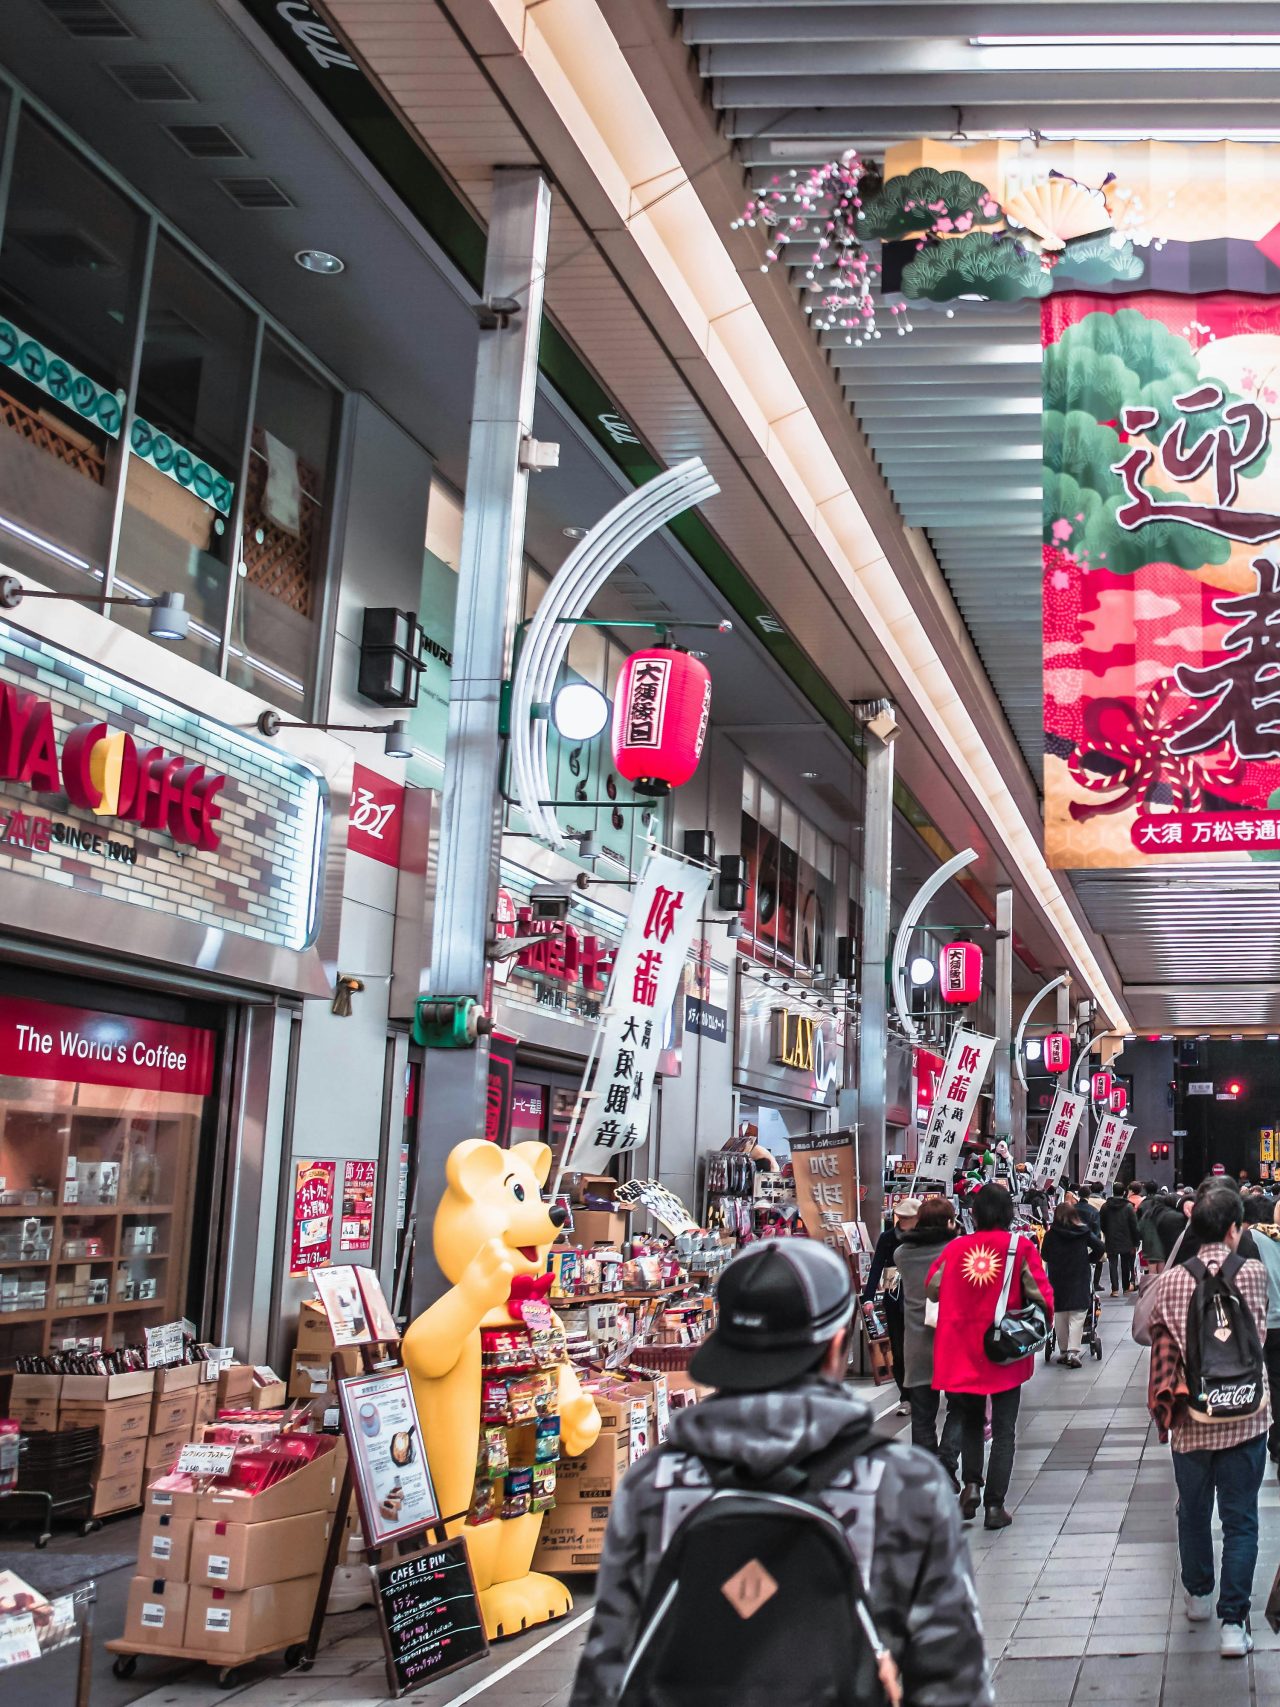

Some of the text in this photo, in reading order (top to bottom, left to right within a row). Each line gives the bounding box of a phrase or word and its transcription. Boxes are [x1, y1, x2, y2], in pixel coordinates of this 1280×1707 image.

[0, 809, 50, 853] 本店
[53, 822, 102, 856] SINCE
[1140, 821, 1183, 845] 大須
[16, 1024, 187, 1071] The World's Coffee
[345, 1161, 374, 1180] 節分会
[542, 1534, 584, 1545] チョコパイ
[390, 1553, 447, 1584] CAFÉ LE PIN
